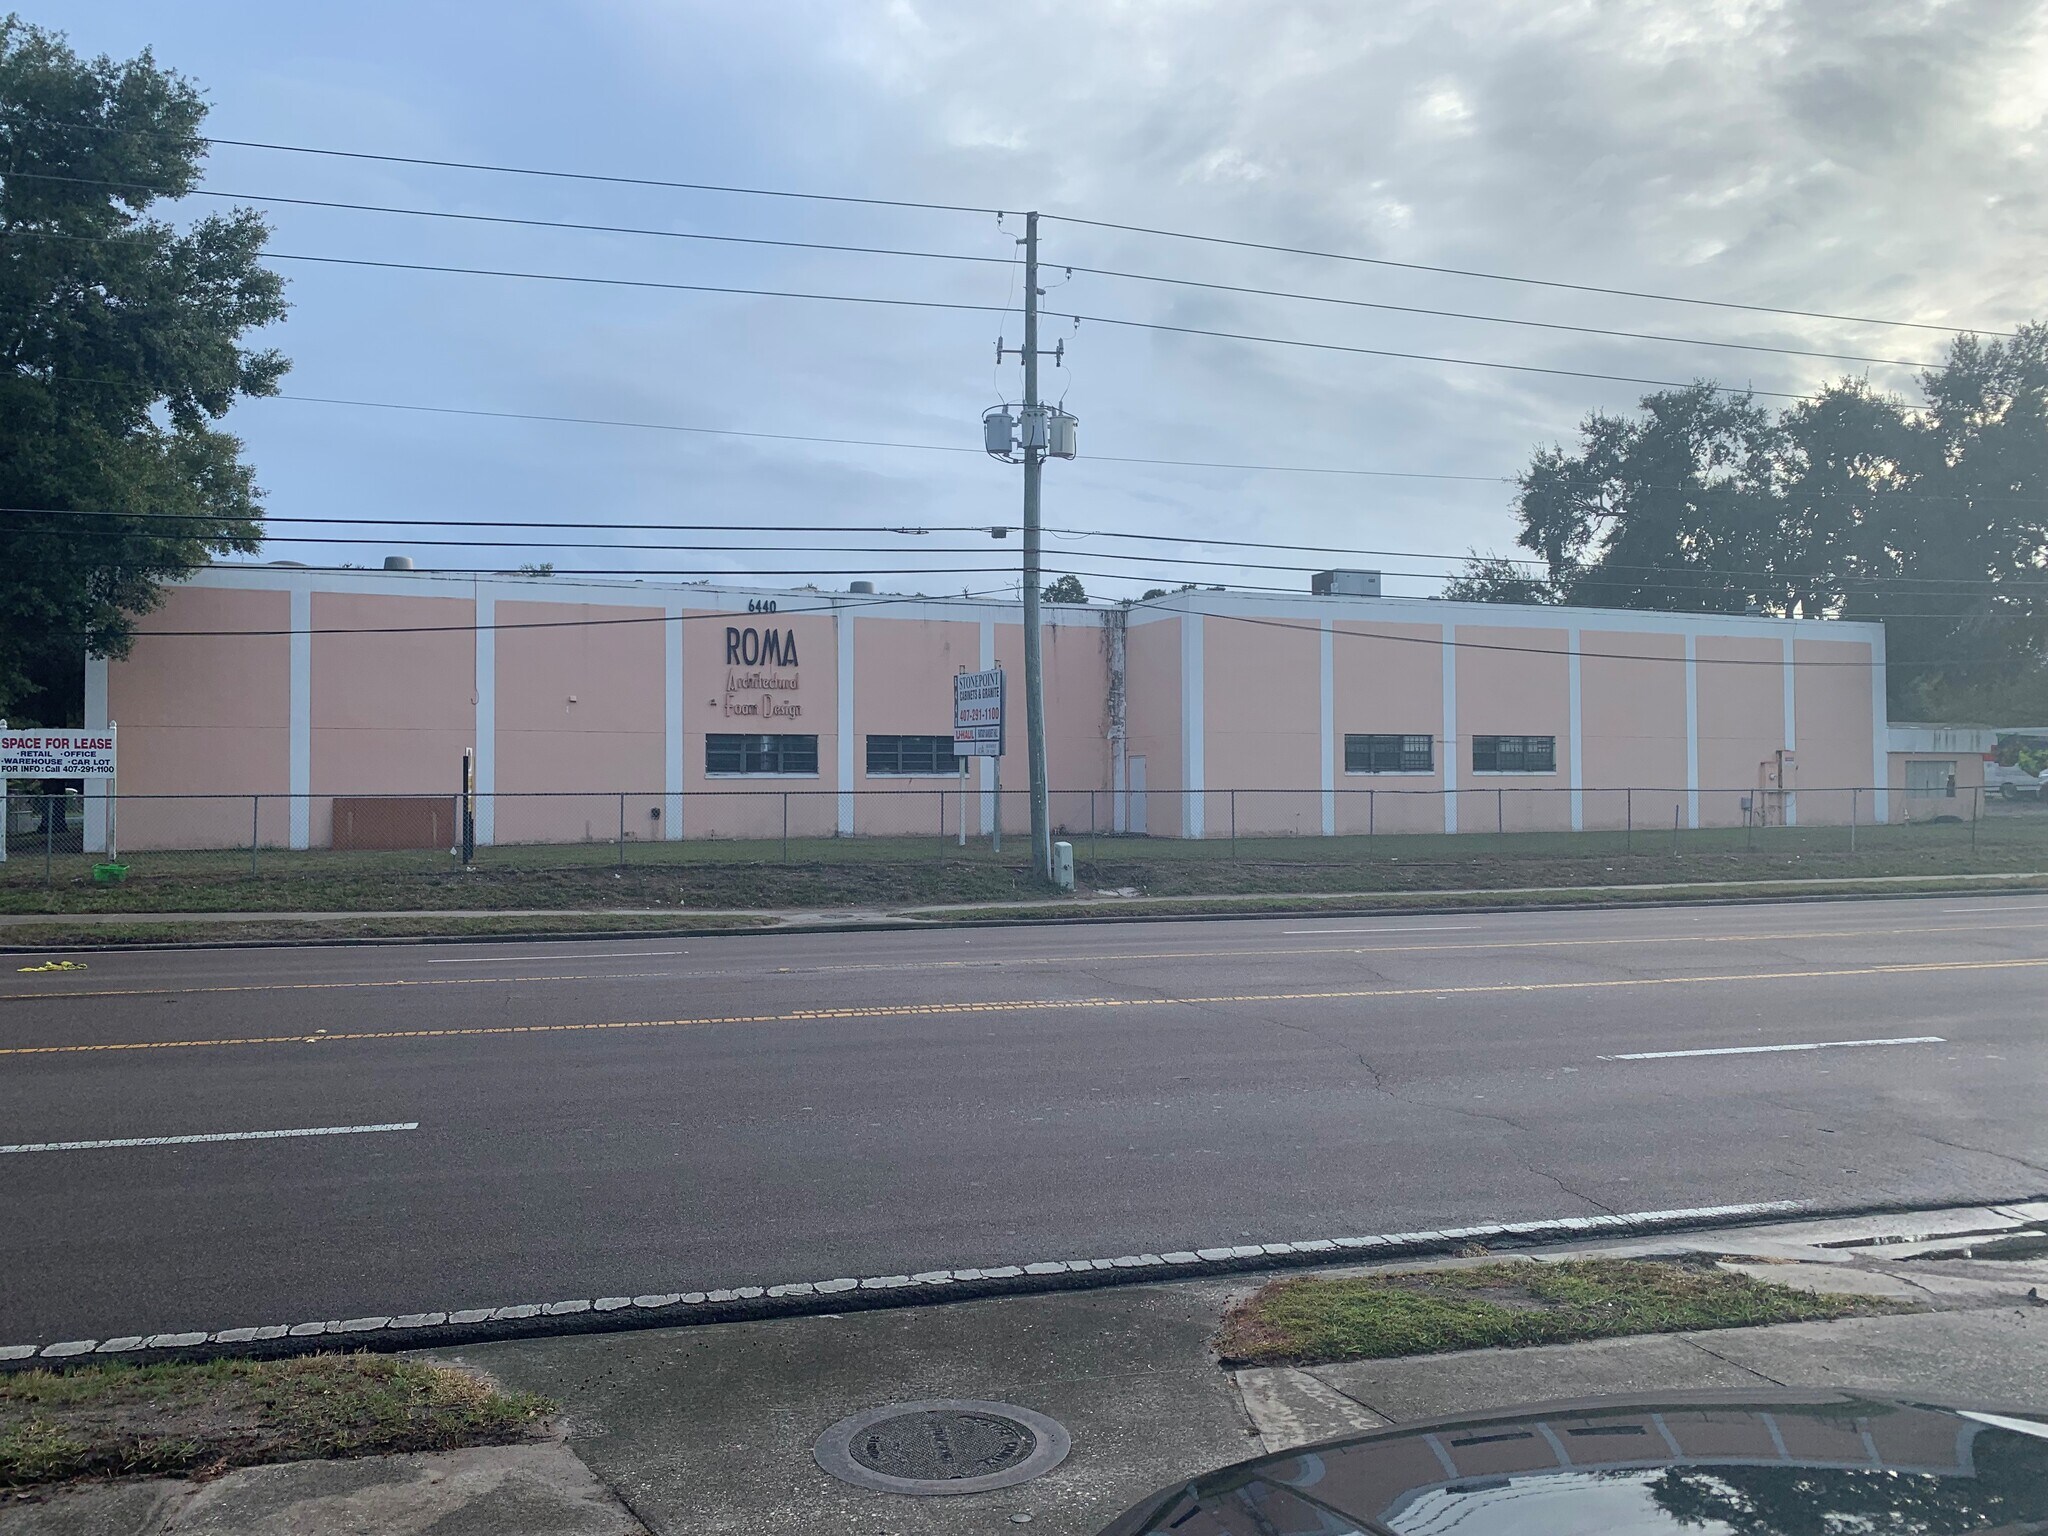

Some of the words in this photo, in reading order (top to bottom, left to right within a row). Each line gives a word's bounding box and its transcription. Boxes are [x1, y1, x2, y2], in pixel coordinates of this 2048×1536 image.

[748, 599, 777, 613] 6440
[726, 626, 799, 667] ROMA
[726, 667, 800, 692] Architectural
[959, 672, 999, 690] STONEPOINT
[959, 688, 978, 701] CABINETS
[982, 687, 999, 699] GRANITE
[724, 693, 759, 718] Foam
[763, 693, 802, 720] Design
[960, 707, 999, 721] 407-291-1100
[2, 738, 41, 749] SPACE
[45, 738, 70, 749] FOR
[74, 738, 112, 749] LEASE
